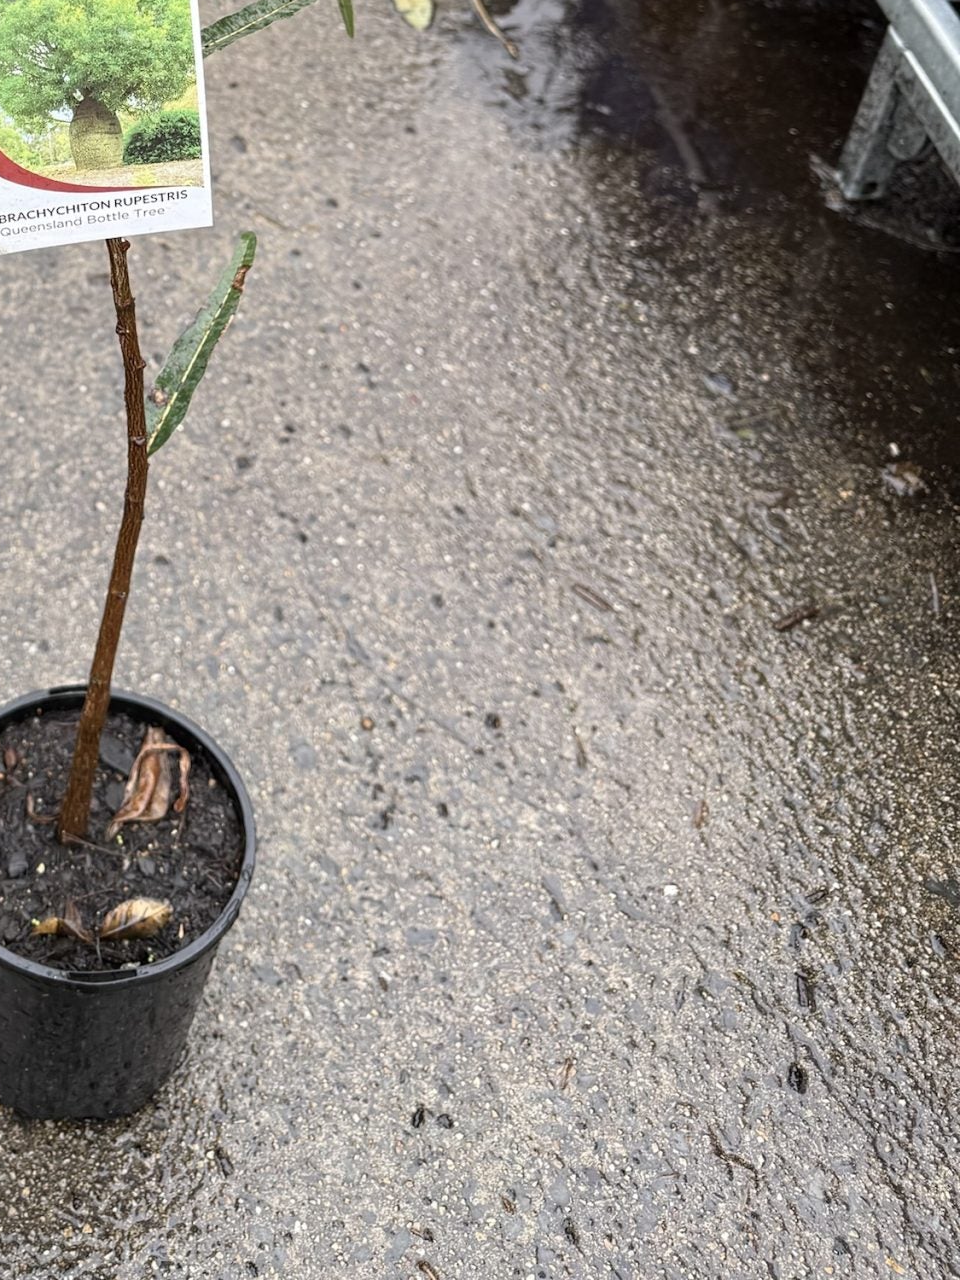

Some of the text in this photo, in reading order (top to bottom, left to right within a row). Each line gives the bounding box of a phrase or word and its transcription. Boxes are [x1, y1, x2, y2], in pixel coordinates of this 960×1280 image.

[115, 189, 188, 208] RUPESTRIS
[0, 207, 165, 237] Queensland Bottle Tree
